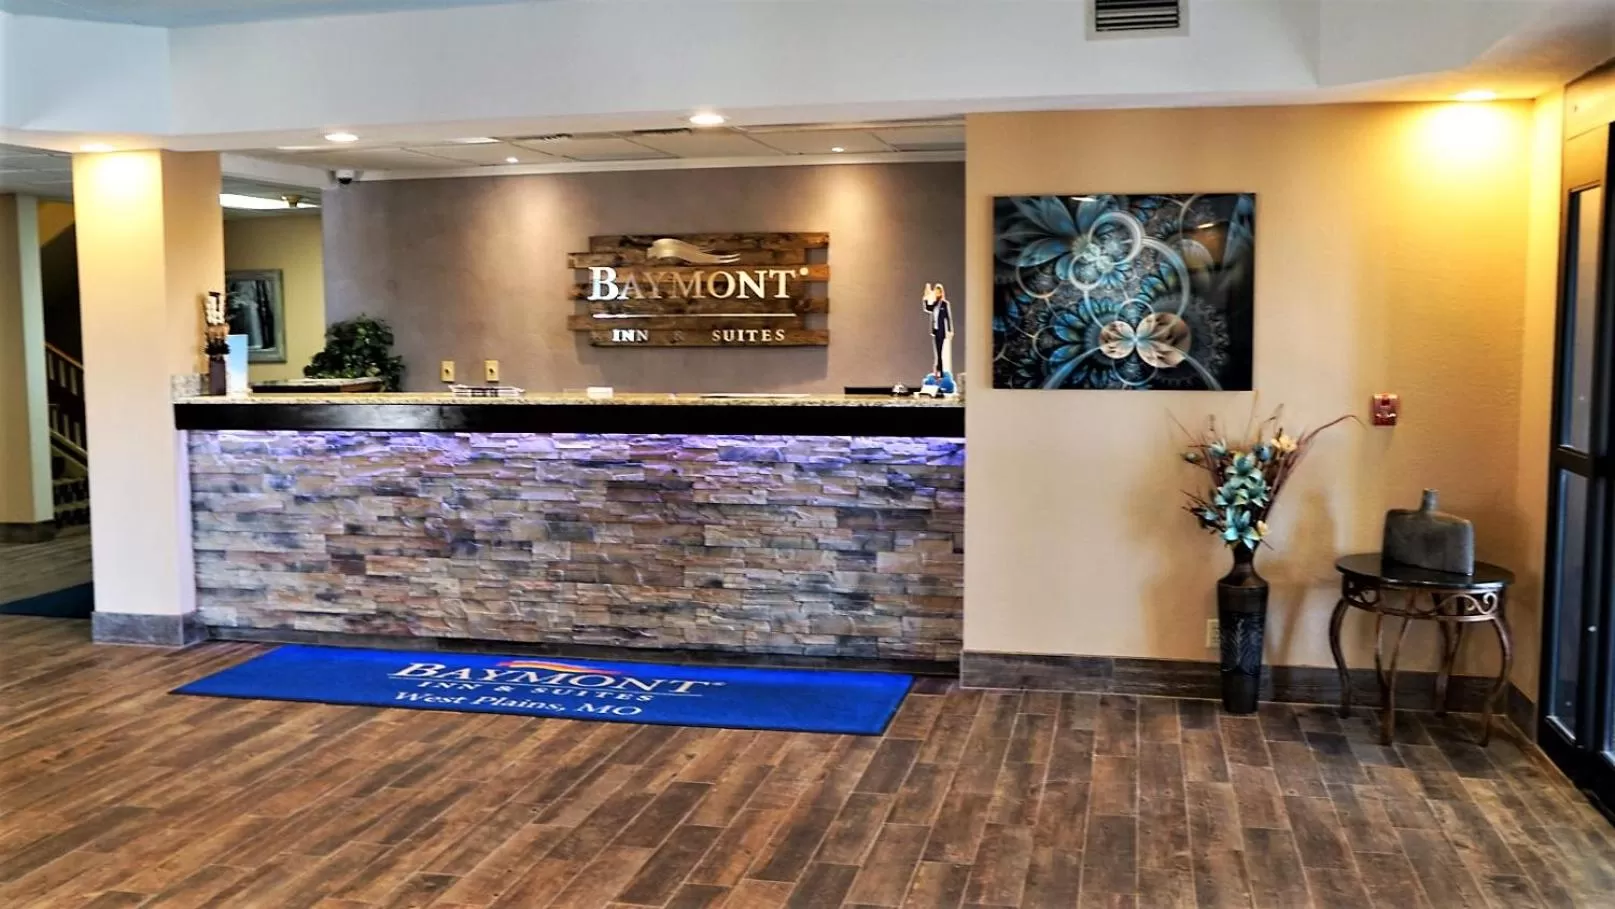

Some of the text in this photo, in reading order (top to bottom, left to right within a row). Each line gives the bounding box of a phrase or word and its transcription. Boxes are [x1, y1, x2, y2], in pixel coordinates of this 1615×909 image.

[587, 265, 797, 300] BAYMONT
[611, 329, 649, 342] INN
[711, 329, 786, 342] SUITES
[386, 662, 707, 694] BAYMONT
[395, 691, 643, 716] West Plains, MO
[416, 681, 655, 701] INN & SUITES
